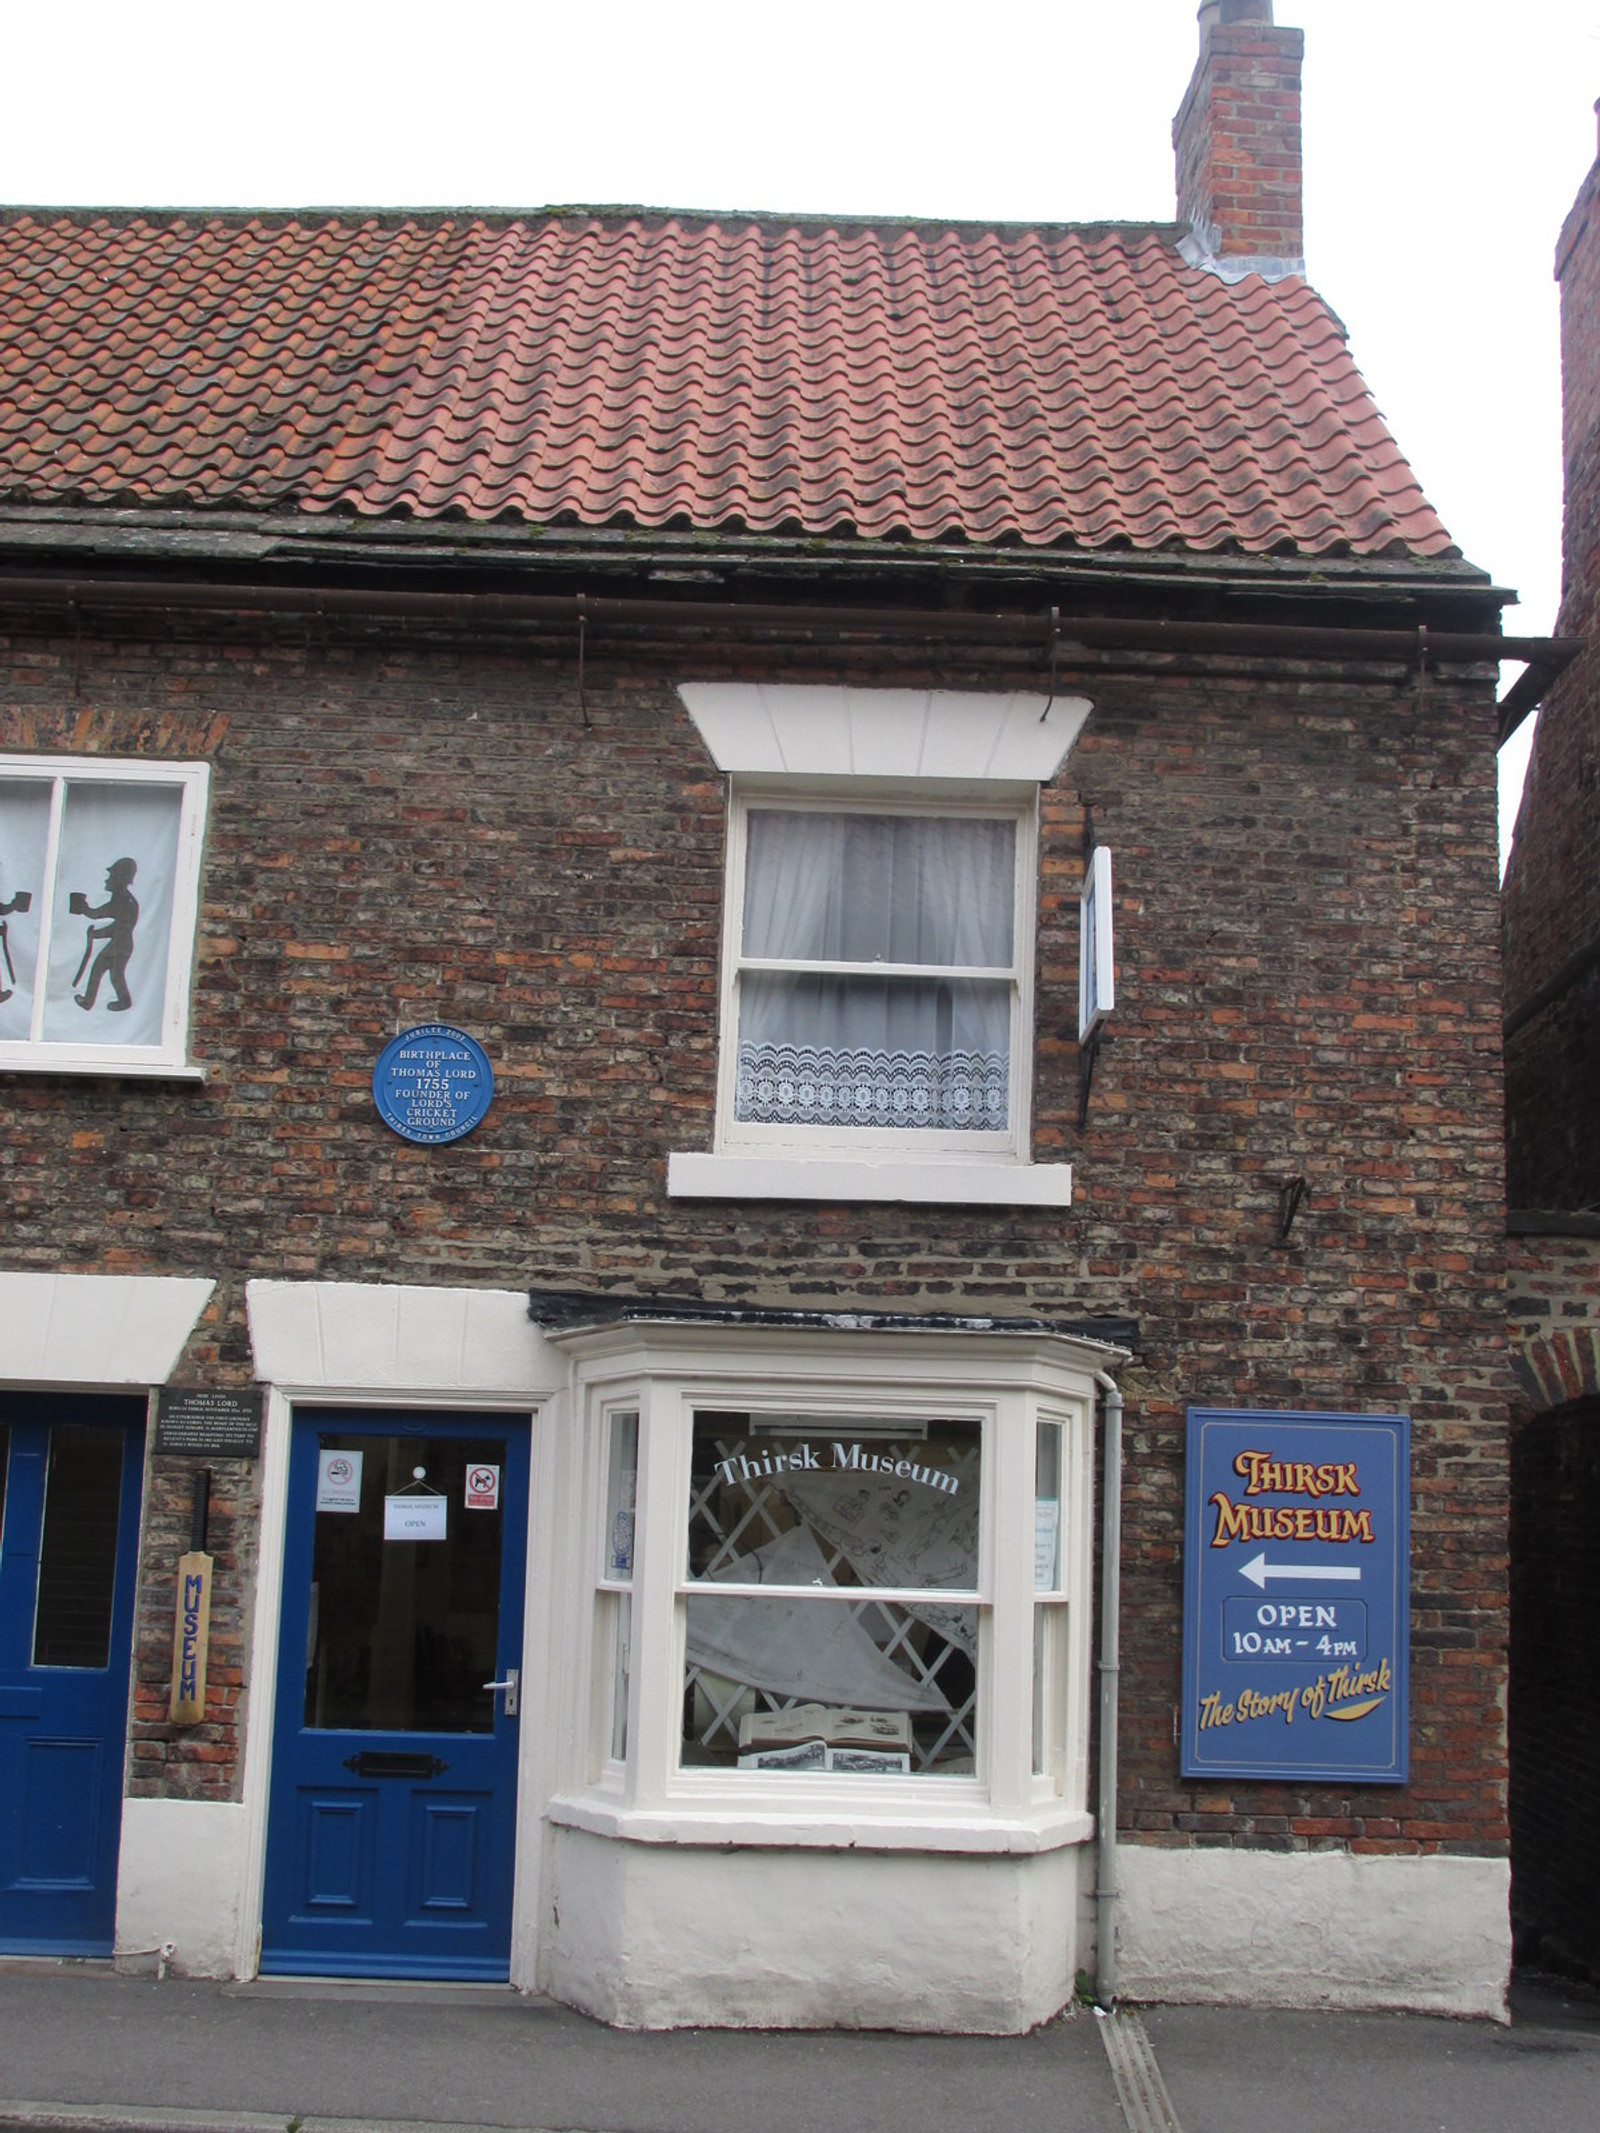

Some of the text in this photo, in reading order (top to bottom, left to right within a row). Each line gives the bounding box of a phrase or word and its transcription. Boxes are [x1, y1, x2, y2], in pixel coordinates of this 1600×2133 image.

[405, 1027, 466, 1041] JUBILEE 2002
[399, 1050, 471, 1060] BIRTHPLACE
[426, 1060, 441, 1069] OF
[390, 1067, 476, 1079] THOMAS LORD
[416, 1078, 449, 1090] 1755
[395, 1089, 471, 1100] FOUNDER OF
[411, 1099, 452, 1108] LORD'S
[406, 1108, 457, 1118] CRICKET
[385, 1112, 411, 1135] THIRSK
[445, 1115, 478, 1138] COUNCIL
[407, 1118, 456, 1127] GROUND
[184, 1399, 215, 1407] THOMAS
[714, 1442, 960, 1496] Thirsk Museum
[1233, 1450, 1361, 1497] THIRSK
[1208, 1491, 1376, 1548] MUSEUM
[1257, 1604, 1337, 1627] OPEN
[179, 1574, 203, 1701] MUSEUM
[1233, 1632, 1292, 1655] 10AM
[1315, 1634, 1358, 1656] 4PM
[1199, 1658, 1392, 1731] The Story of Thirsk
